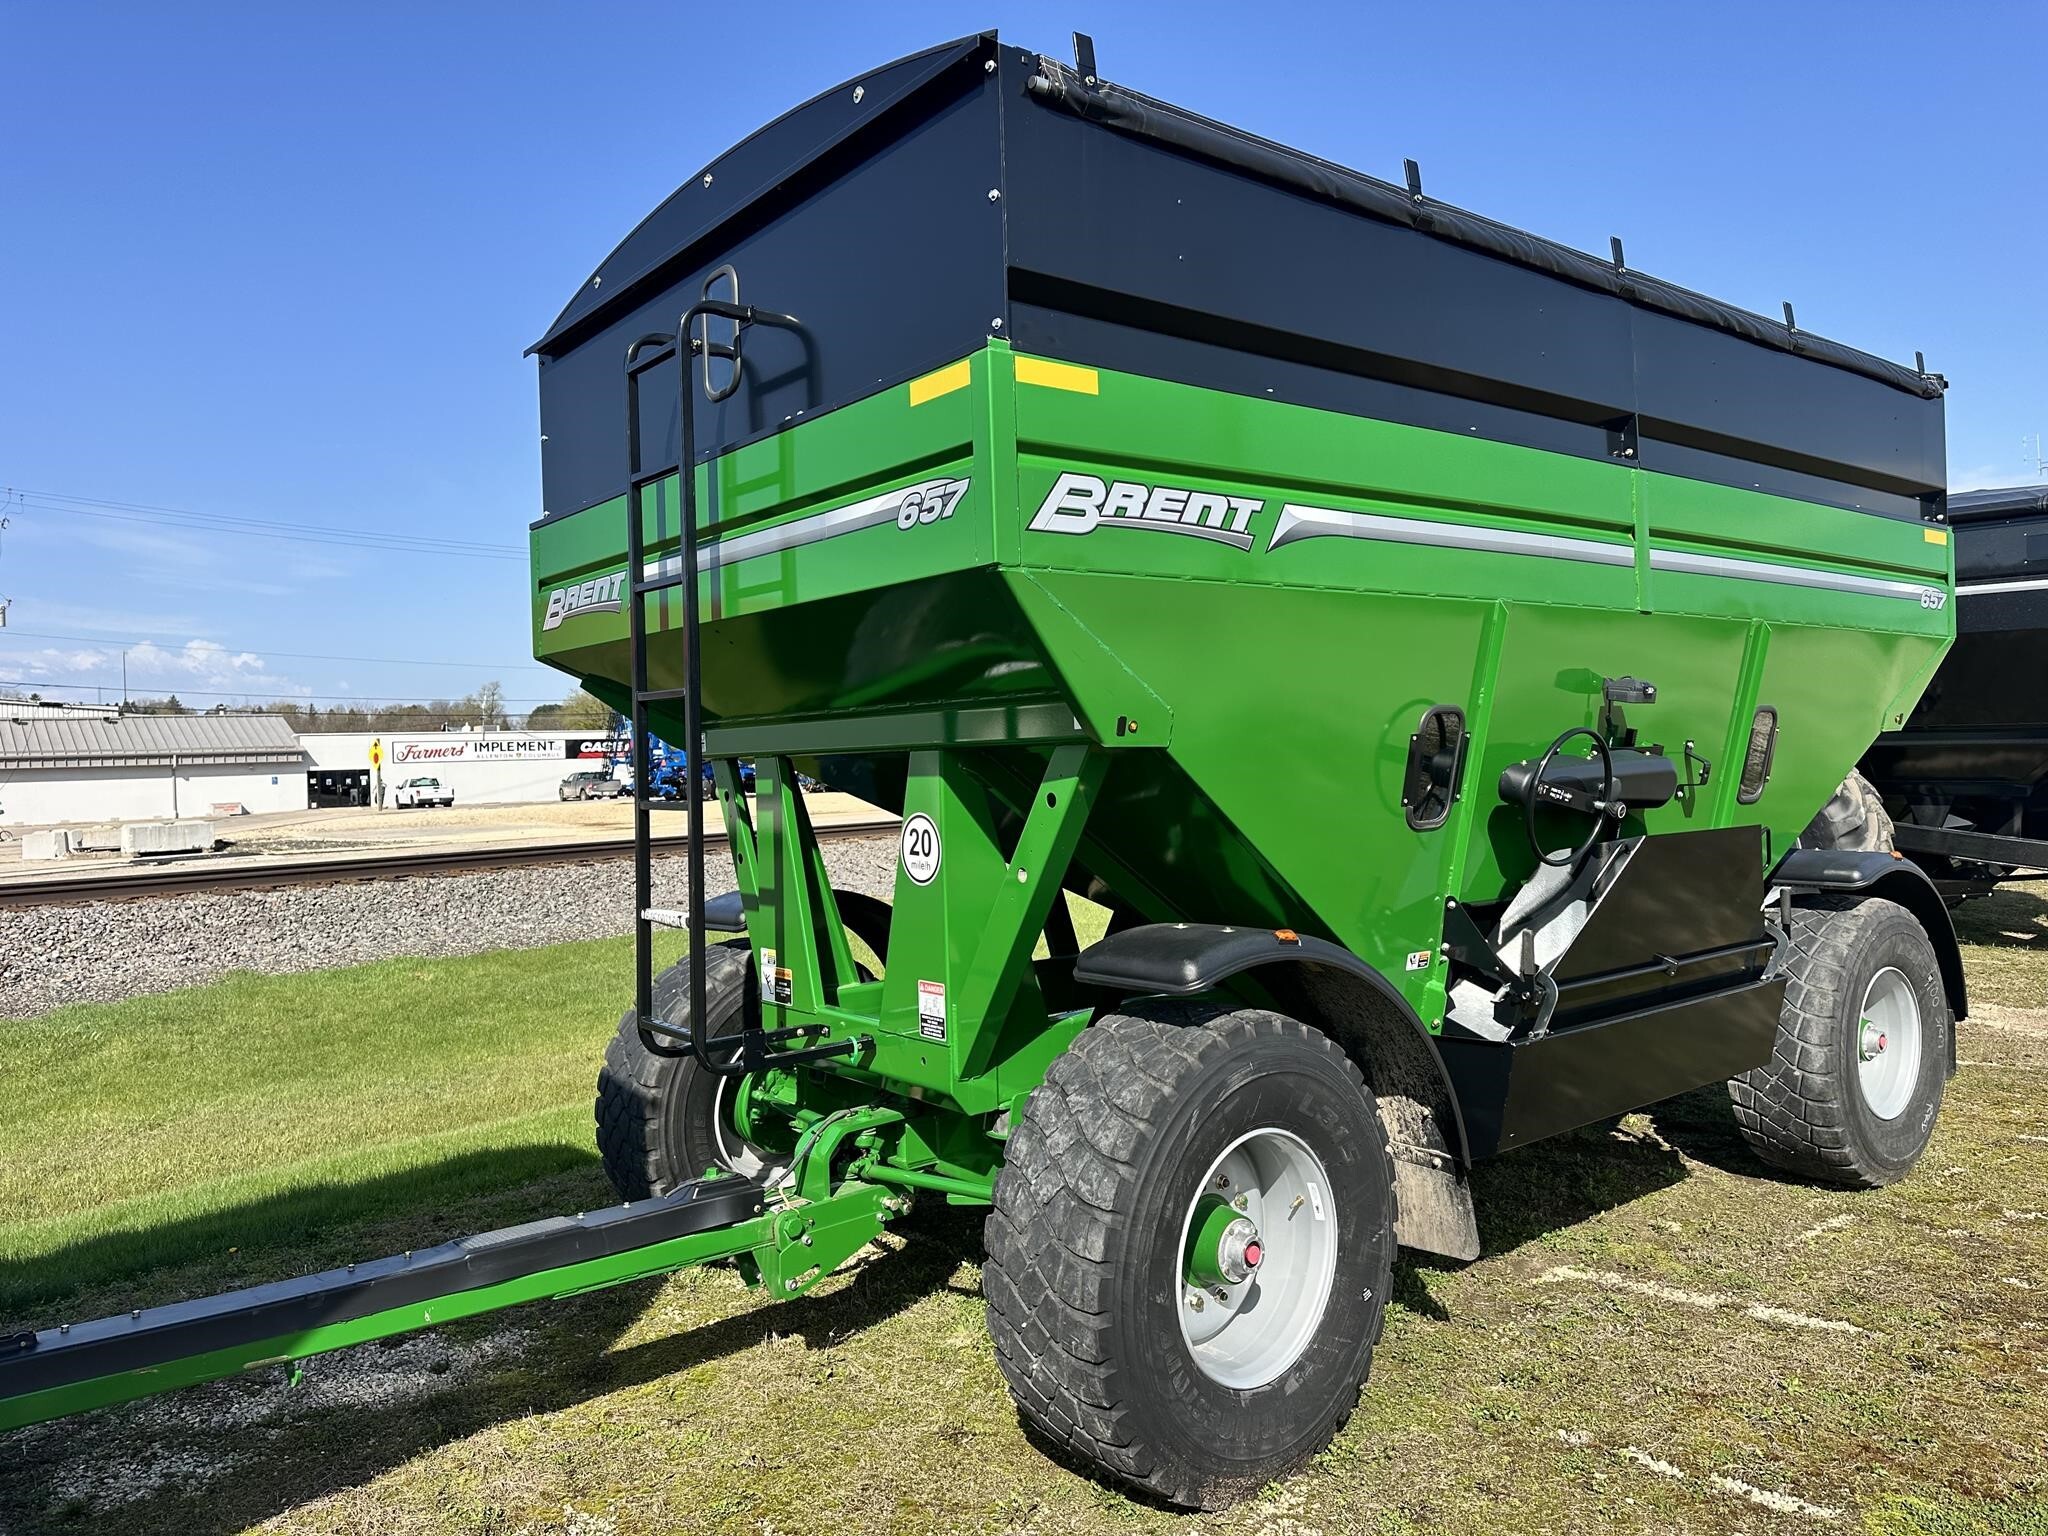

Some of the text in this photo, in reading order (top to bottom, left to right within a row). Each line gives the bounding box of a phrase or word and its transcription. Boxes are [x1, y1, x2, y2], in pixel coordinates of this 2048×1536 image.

[895, 478, 970, 531] 657
[1025, 471, 1265, 536] BRENT
[542, 570, 628, 632] BRENT
[1920, 589, 1948, 611] 657
[396, 741, 469, 762] Farmers'
[474, 741, 555, 752] IMPLEMENT
[909, 828, 931, 857] 20
